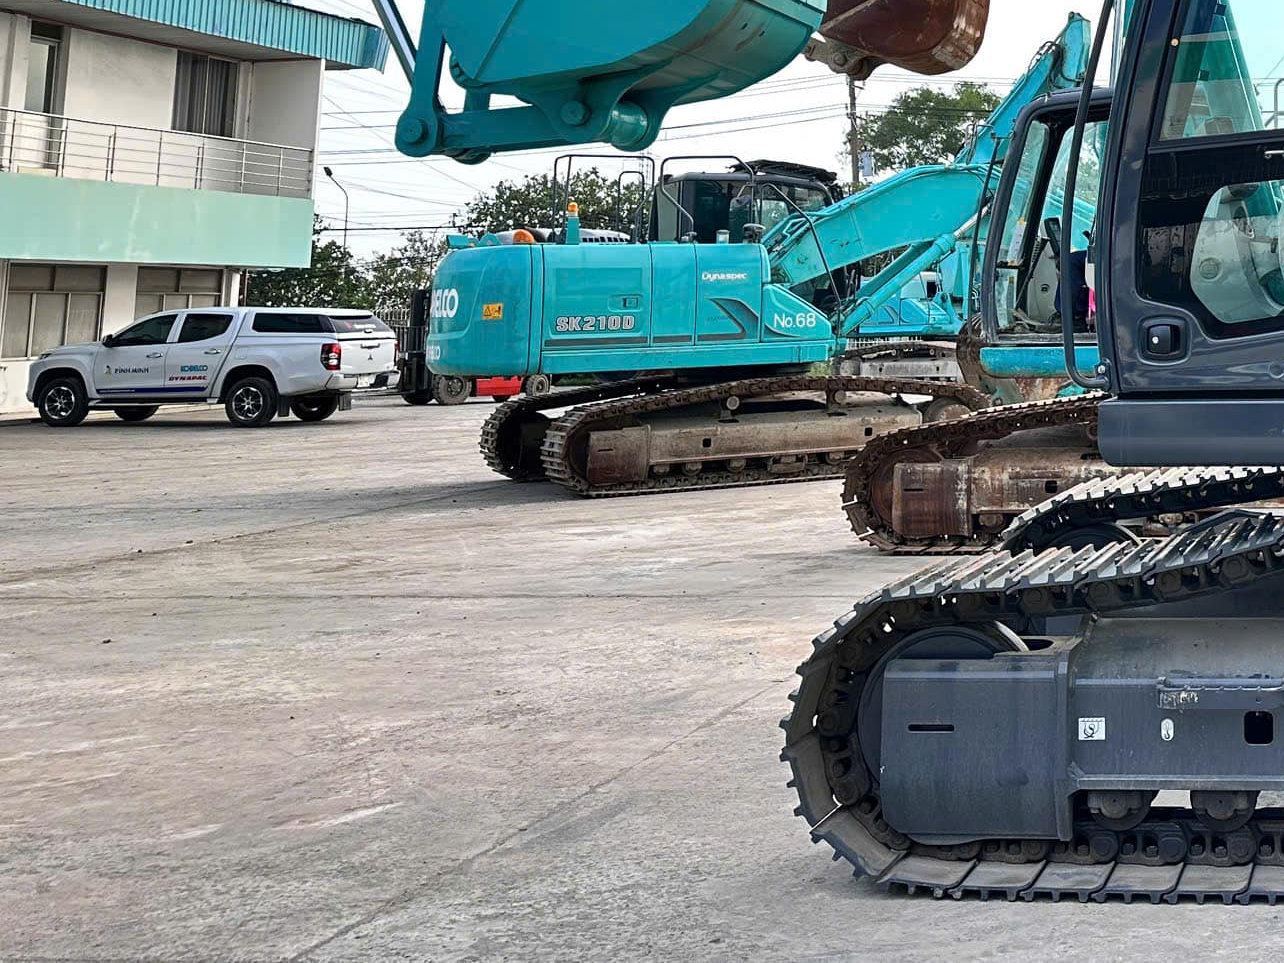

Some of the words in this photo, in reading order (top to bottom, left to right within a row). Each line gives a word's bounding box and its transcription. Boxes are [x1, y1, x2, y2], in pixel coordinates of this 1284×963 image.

[701, 271, 748, 282] Dynaspec
[555, 315, 635, 332] SK210D
[773, 312, 816, 328] No.68
